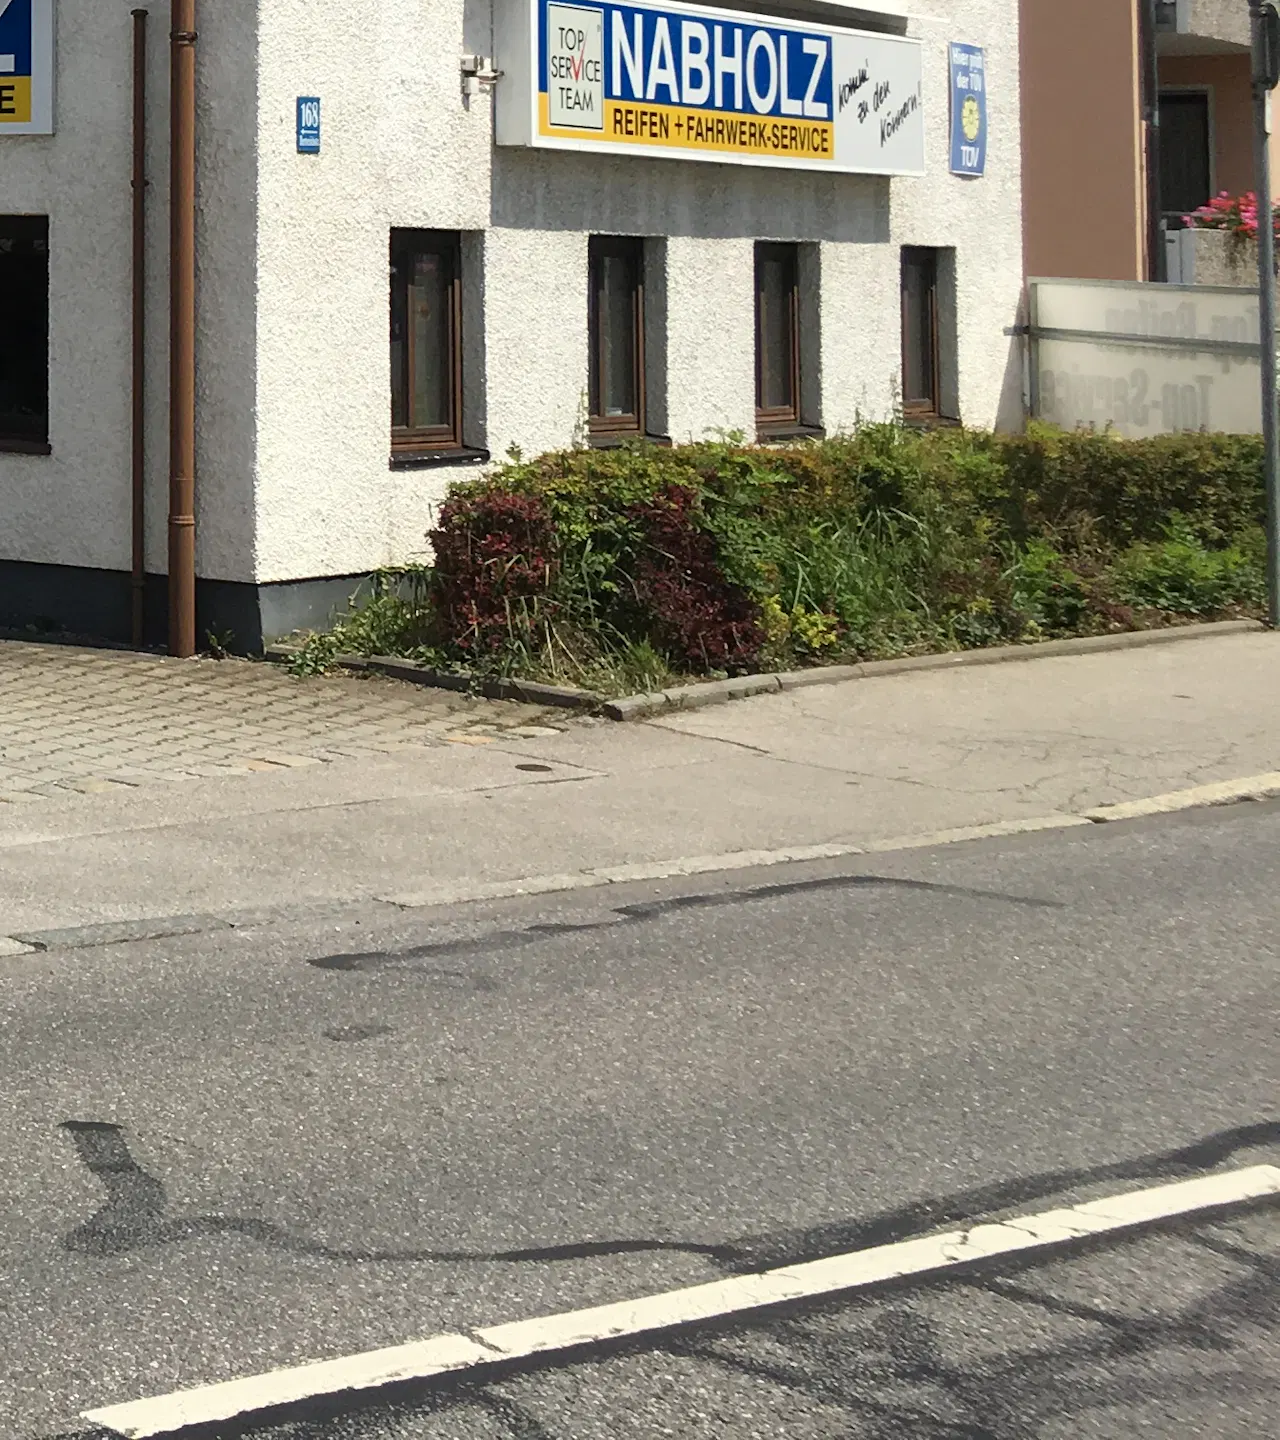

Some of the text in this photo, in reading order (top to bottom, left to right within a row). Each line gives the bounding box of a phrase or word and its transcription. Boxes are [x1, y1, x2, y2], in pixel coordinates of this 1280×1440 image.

[558, 27, 585, 51] TOP
[551, 55, 601, 82] SERVICE
[611, 9, 830, 119] NABHOLZ
[558, 87, 593, 112] TEAM
[858, 80, 891, 124] zu den
[300, 102, 319, 128] 168
[613, 107, 670, 140] REIFEN
[687, 115, 829, 153] FAHRWERK-SERVICE
